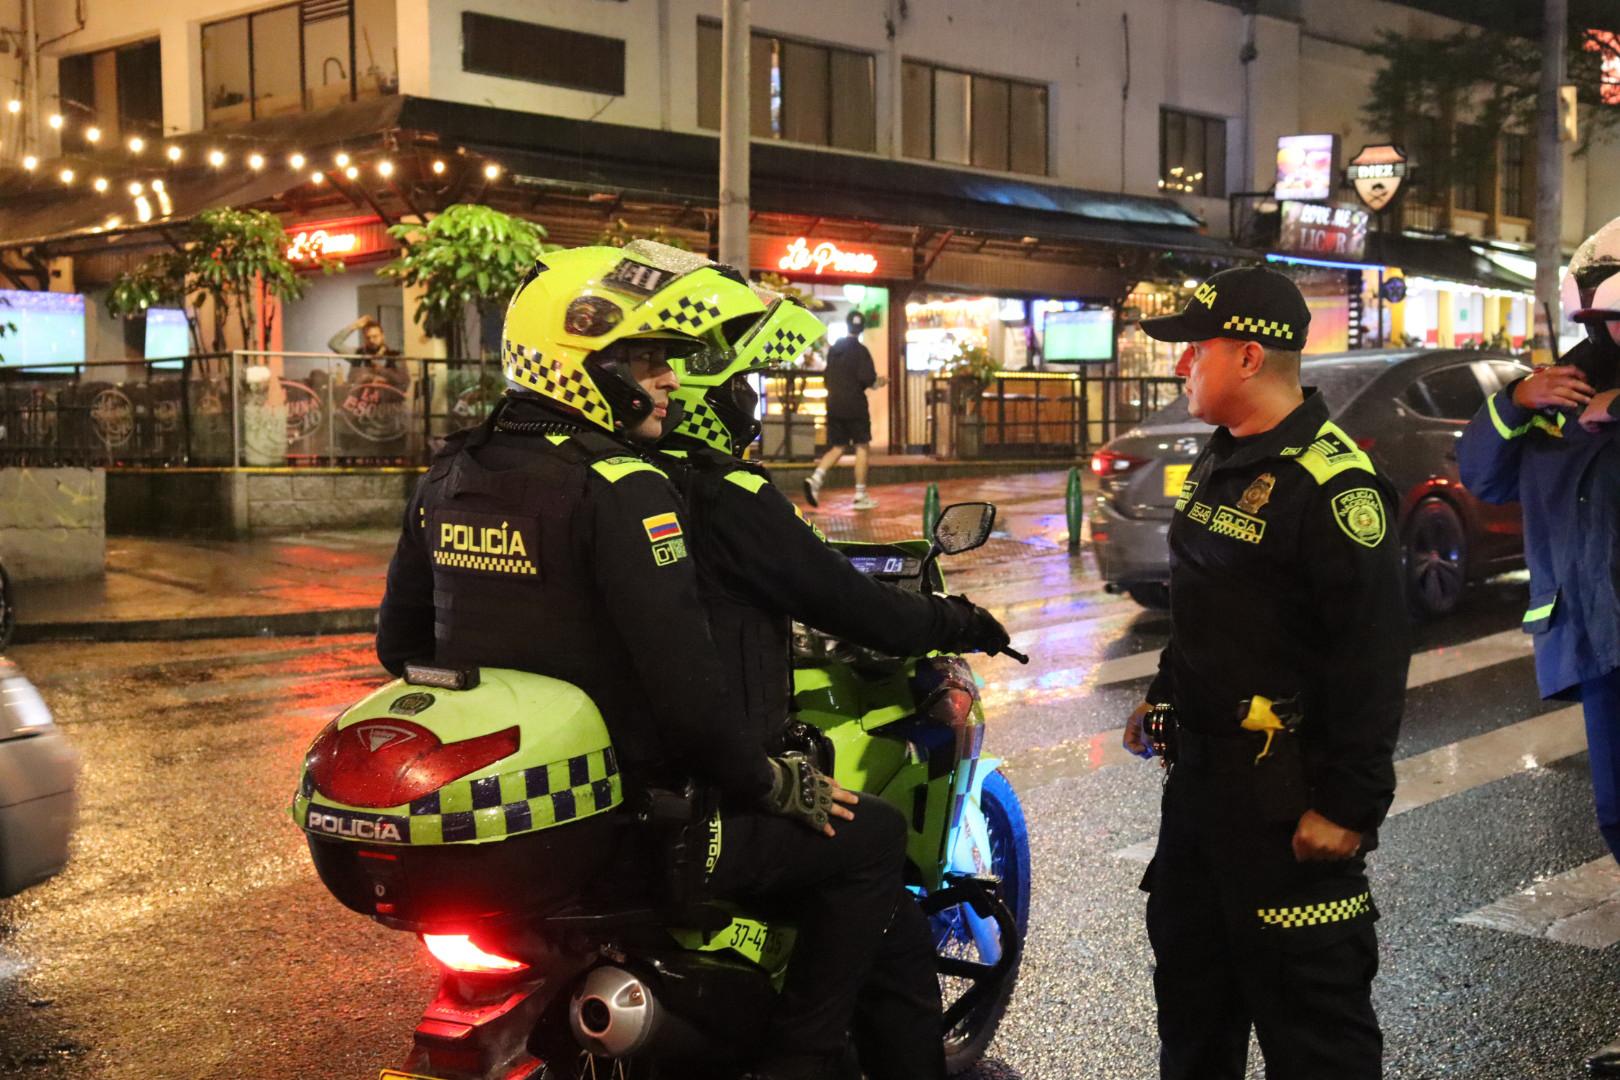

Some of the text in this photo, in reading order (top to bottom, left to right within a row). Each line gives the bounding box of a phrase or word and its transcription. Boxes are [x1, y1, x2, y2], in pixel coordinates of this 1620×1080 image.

[1217, 511, 1257, 534] POLICÍA
[440, 521, 527, 557] POLICÍA
[308, 812, 402, 841] POLICÍA
